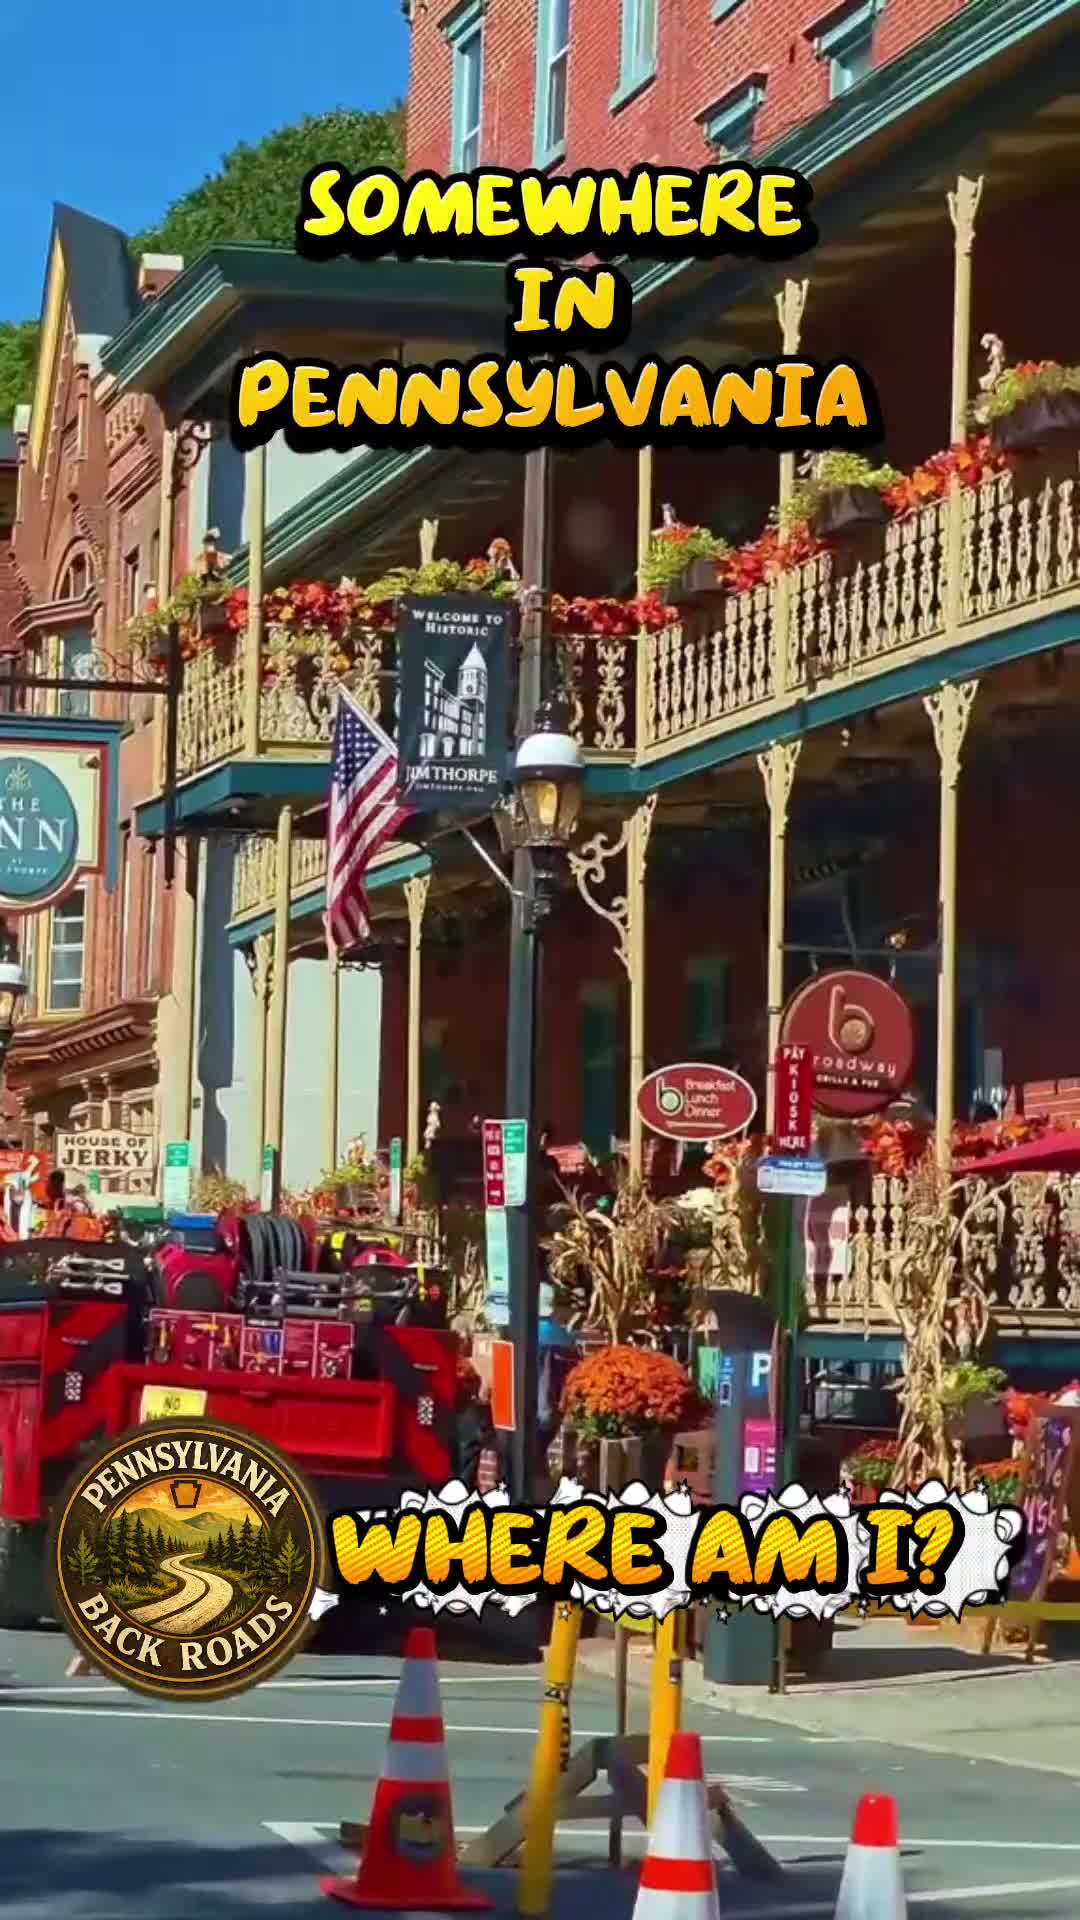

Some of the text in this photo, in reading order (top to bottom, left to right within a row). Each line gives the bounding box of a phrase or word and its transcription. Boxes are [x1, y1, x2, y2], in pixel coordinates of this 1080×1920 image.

[412, 609, 504, 625] WELCOME TO
[404, 766, 497, 784] JIM THORPE
[0, 815, 68, 852] NN
[783, 1047, 806, 1060] PAY
[685, 1091, 720, 1104] Lunch
[788, 1064, 800, 1132] KIOSK
[685, 1104, 723, 1118] Dinner
[64, 1136, 147, 1147] HOUSE OF
[779, 1136, 807, 1149] HERE
[62, 1150, 149, 1168] JERKY
[752, 1353, 772, 1387] P
[163, 1396, 180, 1410] NO
